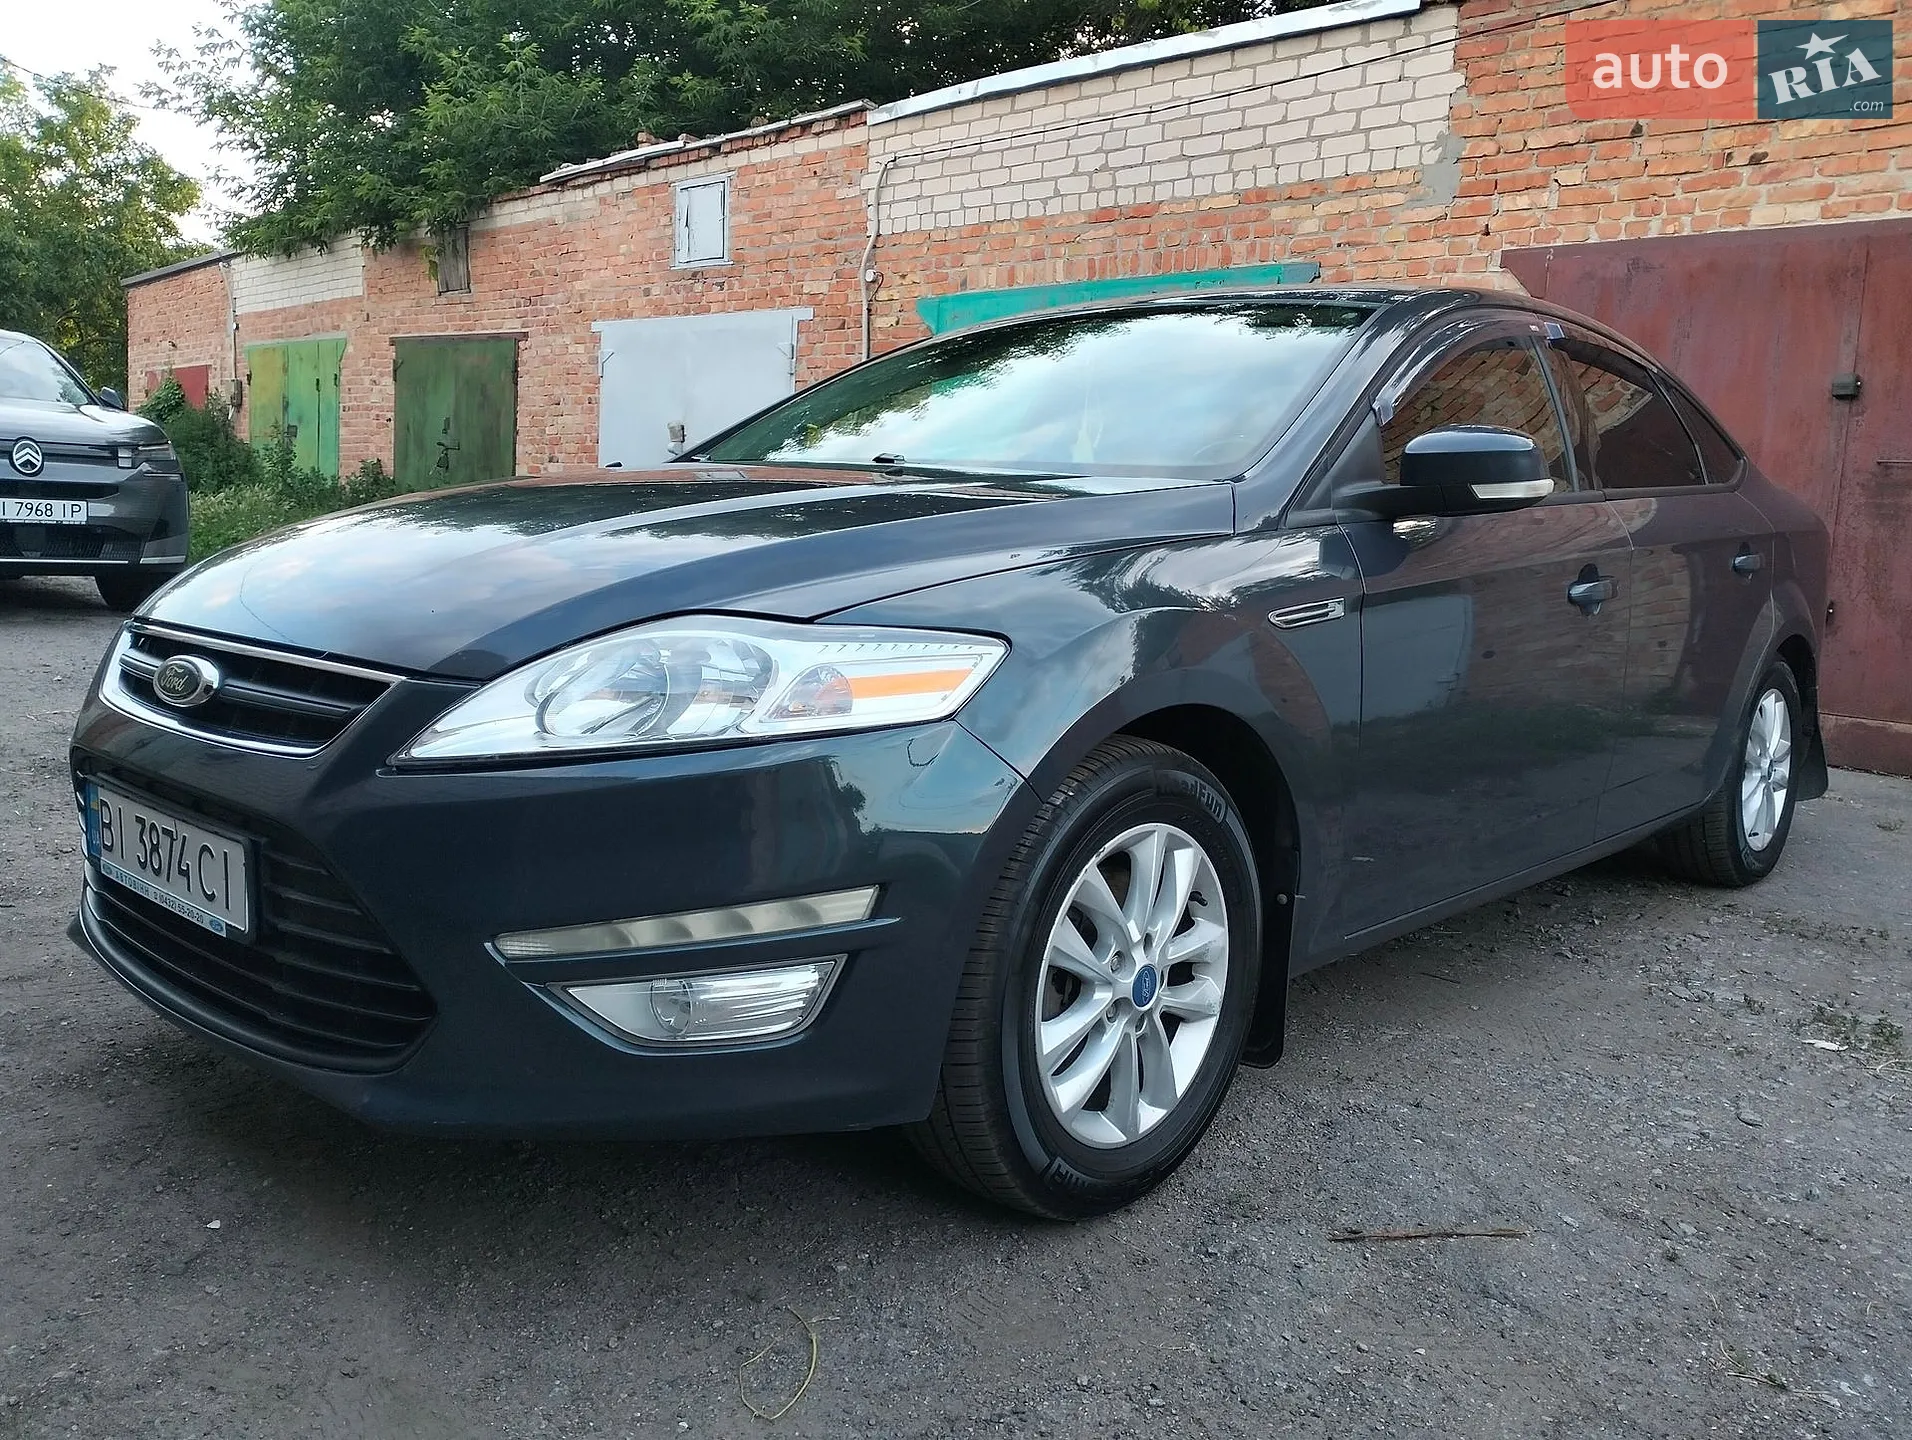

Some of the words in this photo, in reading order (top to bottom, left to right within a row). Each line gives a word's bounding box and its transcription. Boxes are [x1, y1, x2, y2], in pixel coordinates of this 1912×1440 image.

[15, 502, 53, 518] 7968
[63, 503, 82, 518] IP
[161, 665, 189, 691] Ford
[100, 798, 125, 859] BI
[135, 814, 193, 893] 3874
[198, 844, 230, 911] CI
